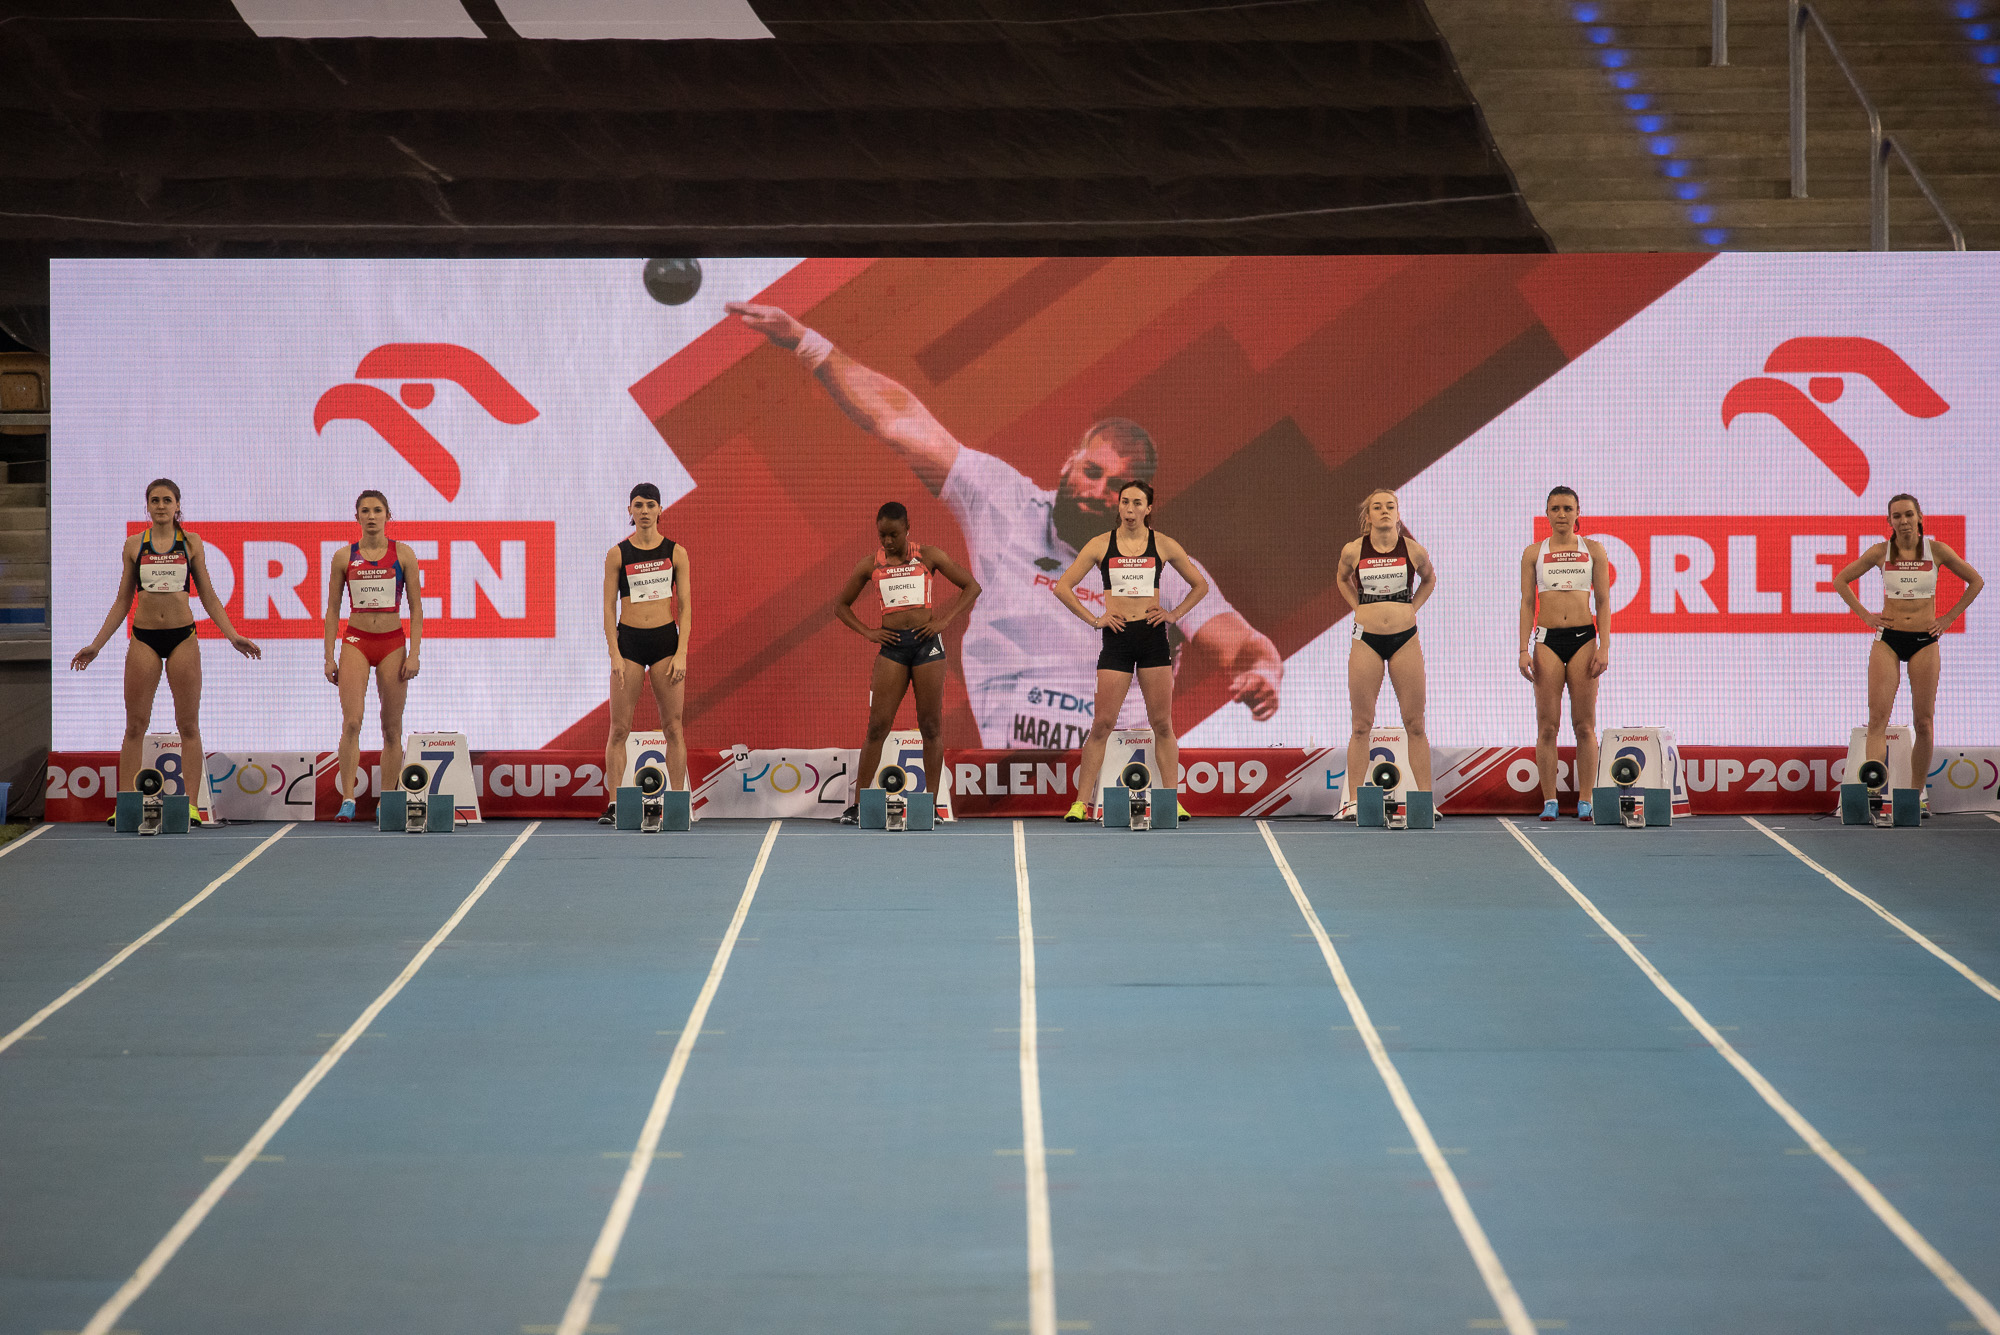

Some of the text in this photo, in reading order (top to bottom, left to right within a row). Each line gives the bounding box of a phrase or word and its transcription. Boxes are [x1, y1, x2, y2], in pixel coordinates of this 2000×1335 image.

[888, 583, 916, 591] BURCHELL
[901, 738, 923, 746] polan
[1125, 736, 1153, 745] polanik
[1372, 735, 1401, 744] polanik
[1621, 734, 1650, 743] polanik
[161, 741, 182, 749] polan
[428, 739, 456, 748] polanik
[735, 753, 748, 761] 5
[155, 752, 182, 797] 8
[420, 751, 455, 795] 7
[896, 749, 926, 798] 5
[1667, 746, 1682, 796] 2
[46, 765, 117, 799] 201
[489, 764, 571, 797] CUP
[945, 762, 1067, 796] RLEN
